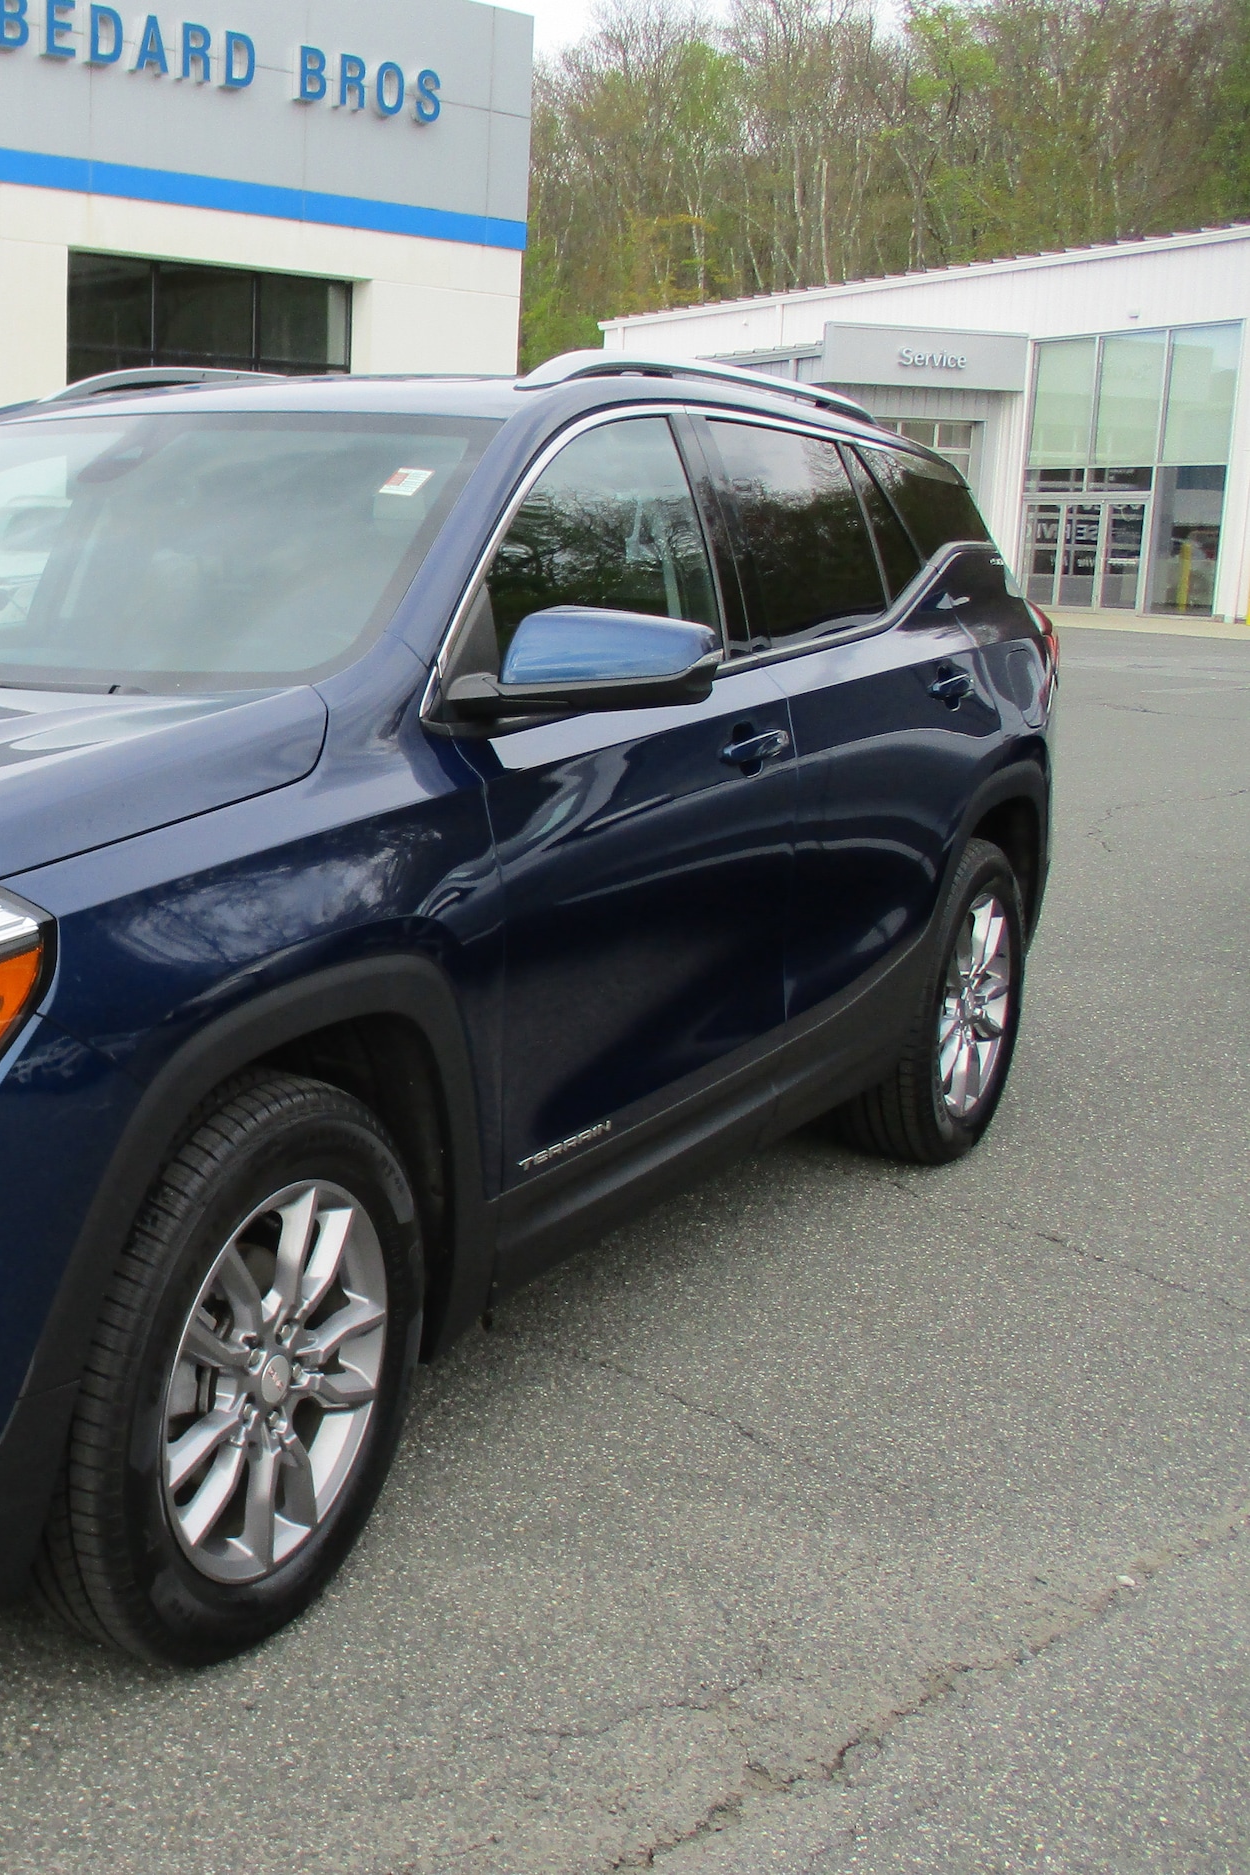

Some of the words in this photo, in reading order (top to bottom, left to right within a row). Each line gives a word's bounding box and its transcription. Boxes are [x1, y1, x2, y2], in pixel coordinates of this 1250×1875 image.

[294, 44, 442, 124] BROS
[899, 346, 968, 370] Service
[517, 1120, 611, 1171] TERRAIN
